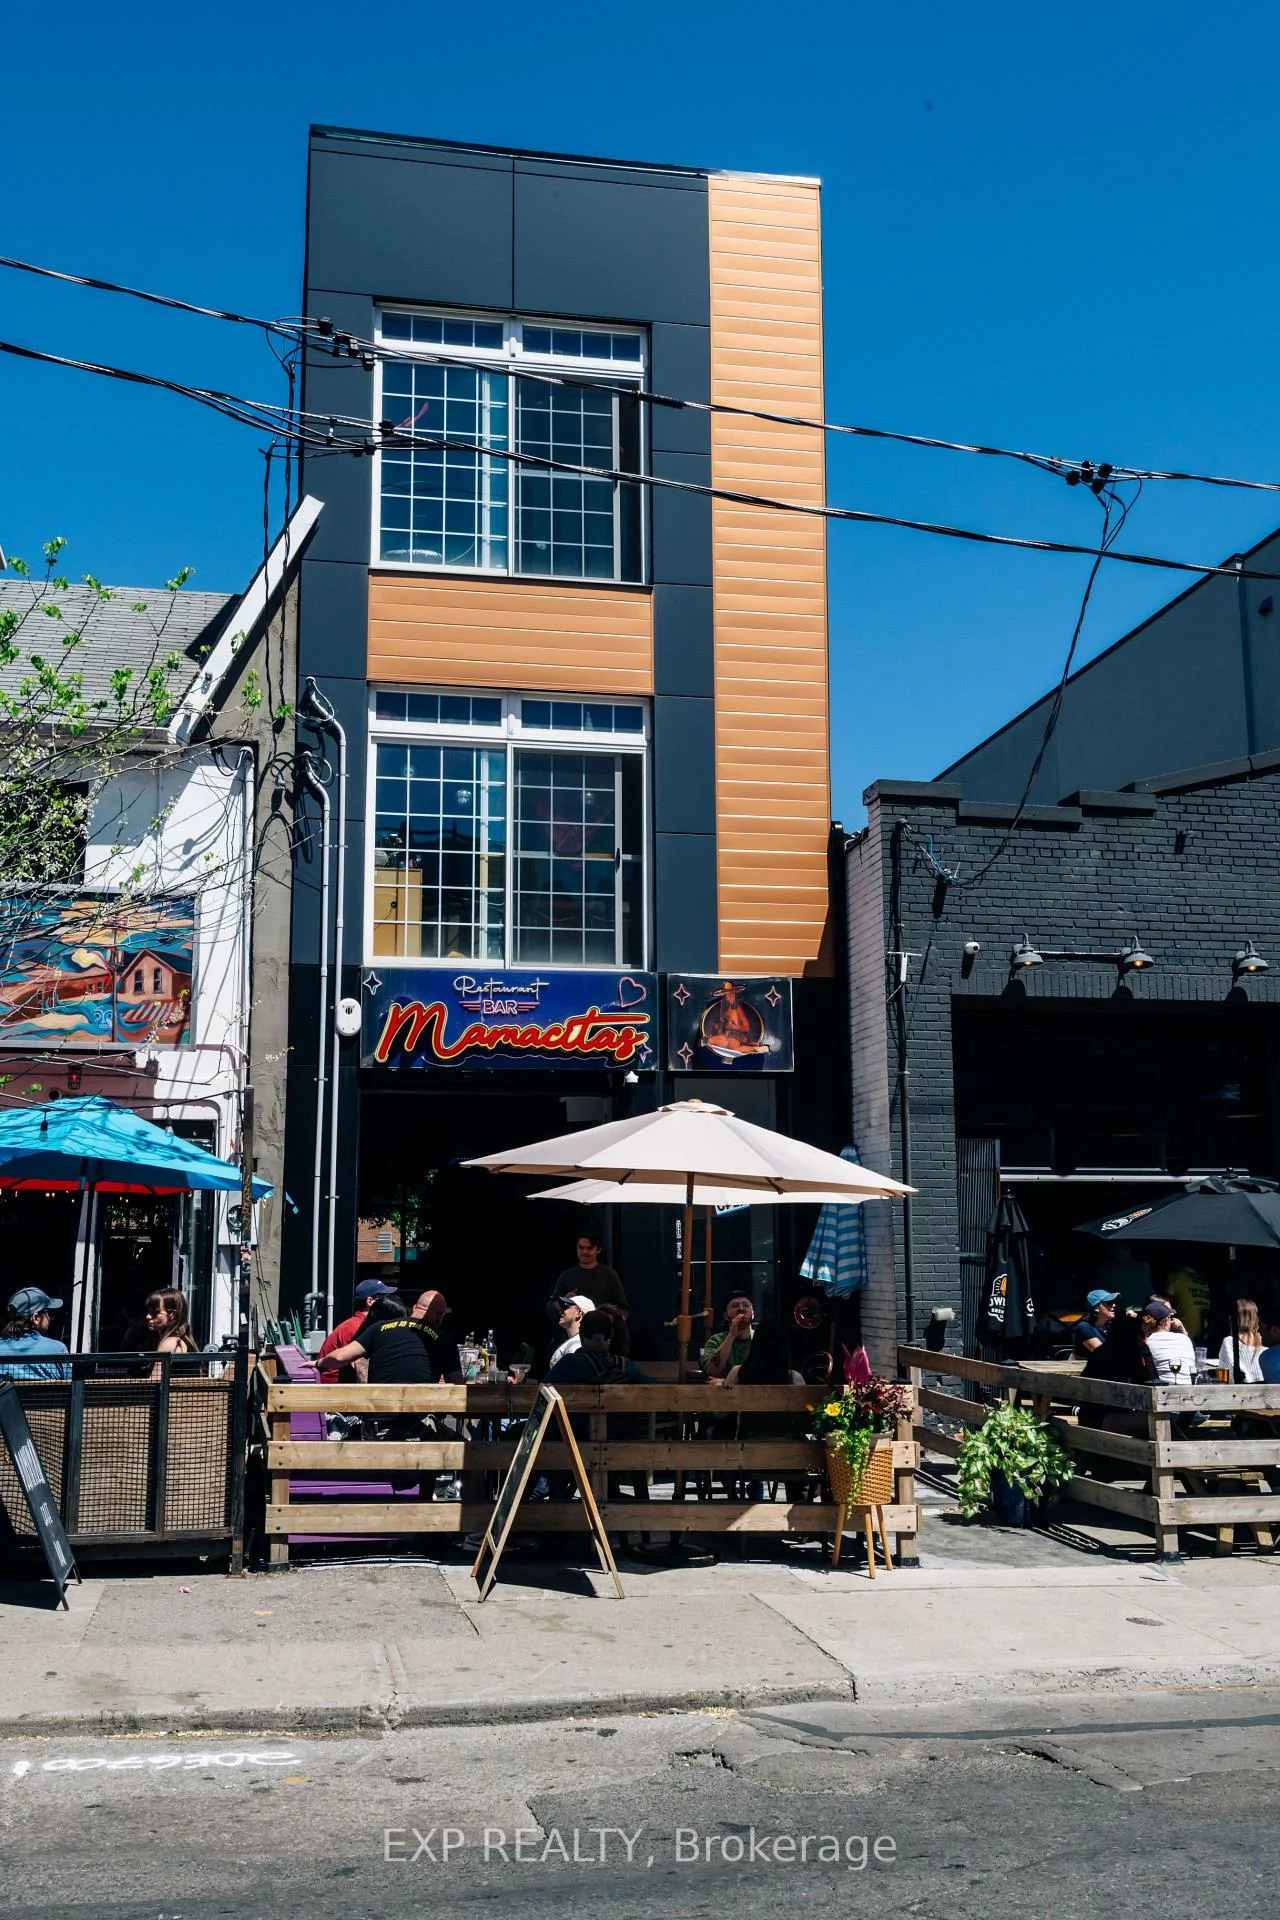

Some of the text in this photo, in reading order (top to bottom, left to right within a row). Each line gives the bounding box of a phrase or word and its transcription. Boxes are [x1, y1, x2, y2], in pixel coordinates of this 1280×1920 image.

[453, 975, 550, 999] Restaurant
[483, 1000, 518, 1015] BAR
[375, 1001, 650, 1062] Mamacitas
